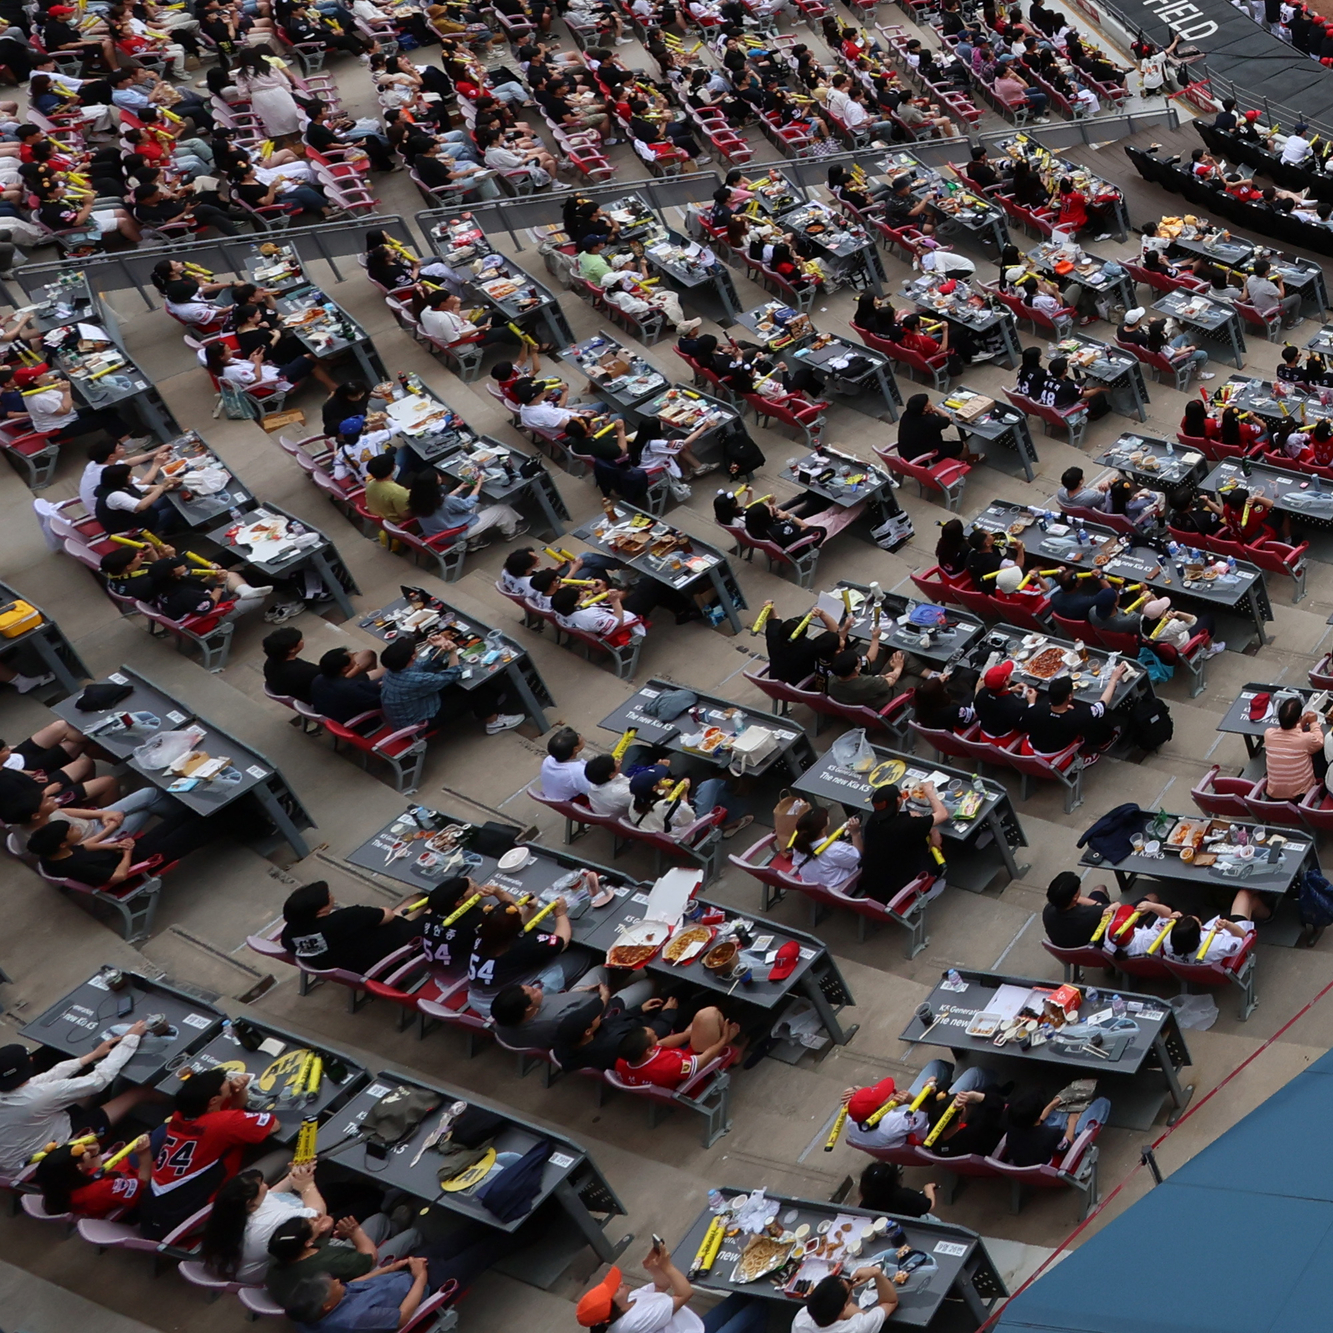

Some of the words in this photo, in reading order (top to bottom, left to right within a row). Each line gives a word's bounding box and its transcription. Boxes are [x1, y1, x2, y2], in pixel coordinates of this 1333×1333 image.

[1040, 389, 1056, 407] 48
[422, 940, 451, 966] 54
[467, 954, 496, 985] 54
